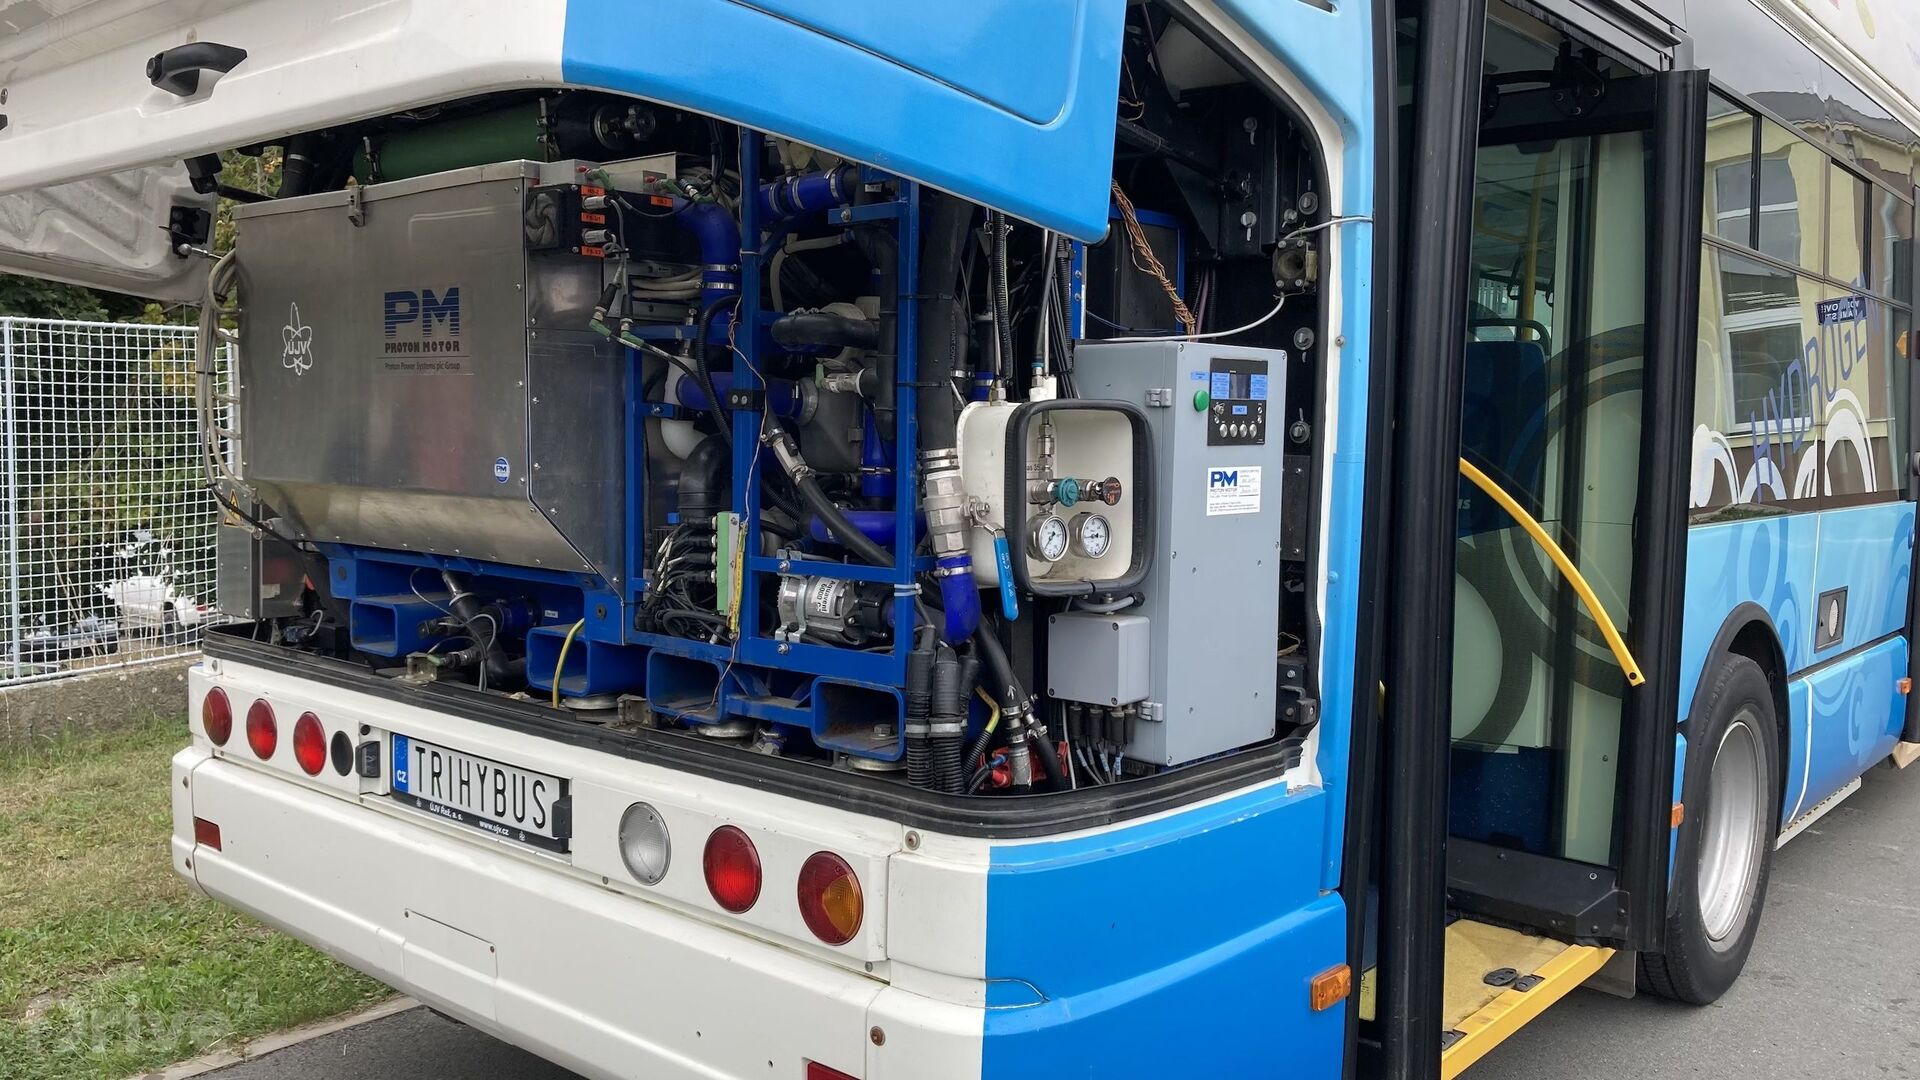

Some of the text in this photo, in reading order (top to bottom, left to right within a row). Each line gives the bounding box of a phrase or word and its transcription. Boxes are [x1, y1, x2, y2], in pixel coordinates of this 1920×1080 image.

[384, 287, 460, 339] PM
[385, 340, 460, 353] PROTON MOTOR
[445, 361, 460, 371] Group
[1210, 470, 1238, 488] PM
[396, 769, 407, 784] CZ
[415, 745, 547, 829] TRIHYBUS
[479, 820, 510, 835] www.ujv.cz
